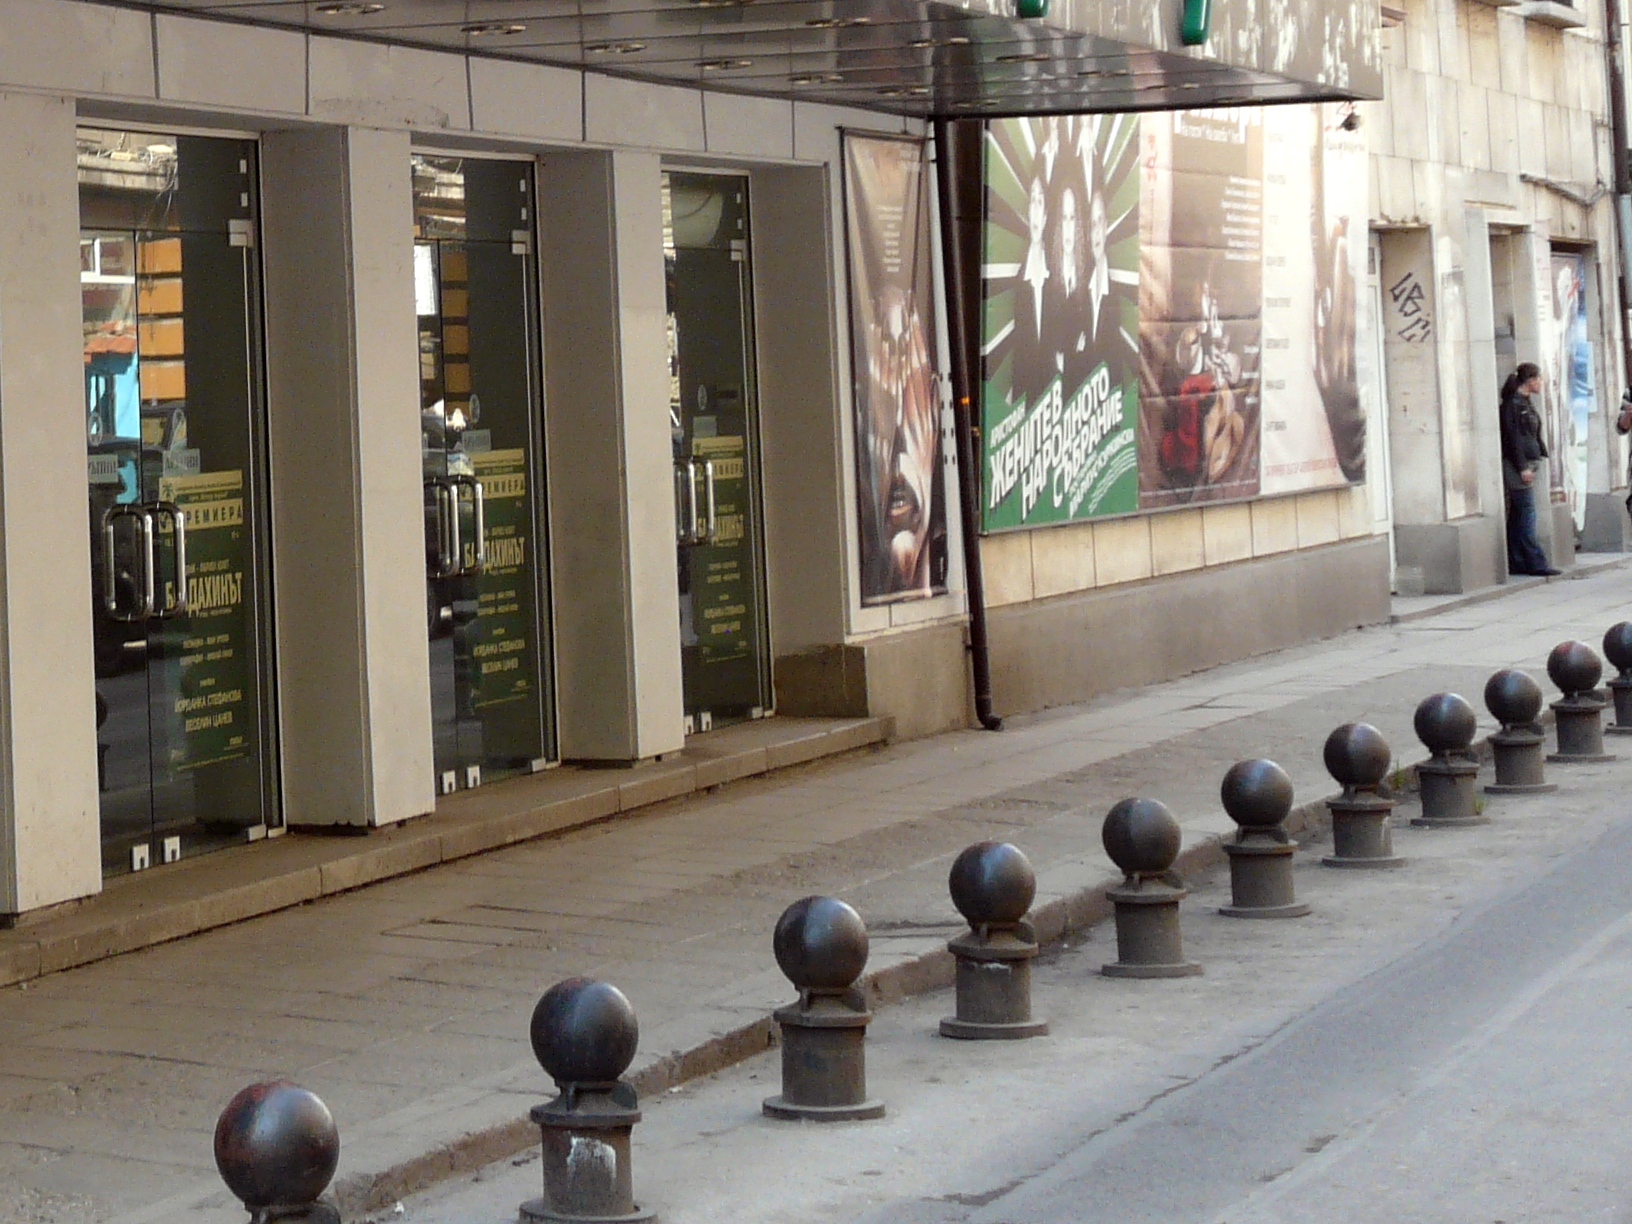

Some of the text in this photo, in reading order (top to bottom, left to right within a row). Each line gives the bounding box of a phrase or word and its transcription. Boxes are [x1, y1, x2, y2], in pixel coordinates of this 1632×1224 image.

[989, 391, 1052, 509] ЖЕНИТЕ
[1021, 367, 1110, 520] НАРОДНОТО
[1053, 390, 1124, 508] СЪБРАНИЕ
[186, 508, 243, 525] РЕМИЕРА
[165, 572, 243, 618] БДАХИНЪТ
